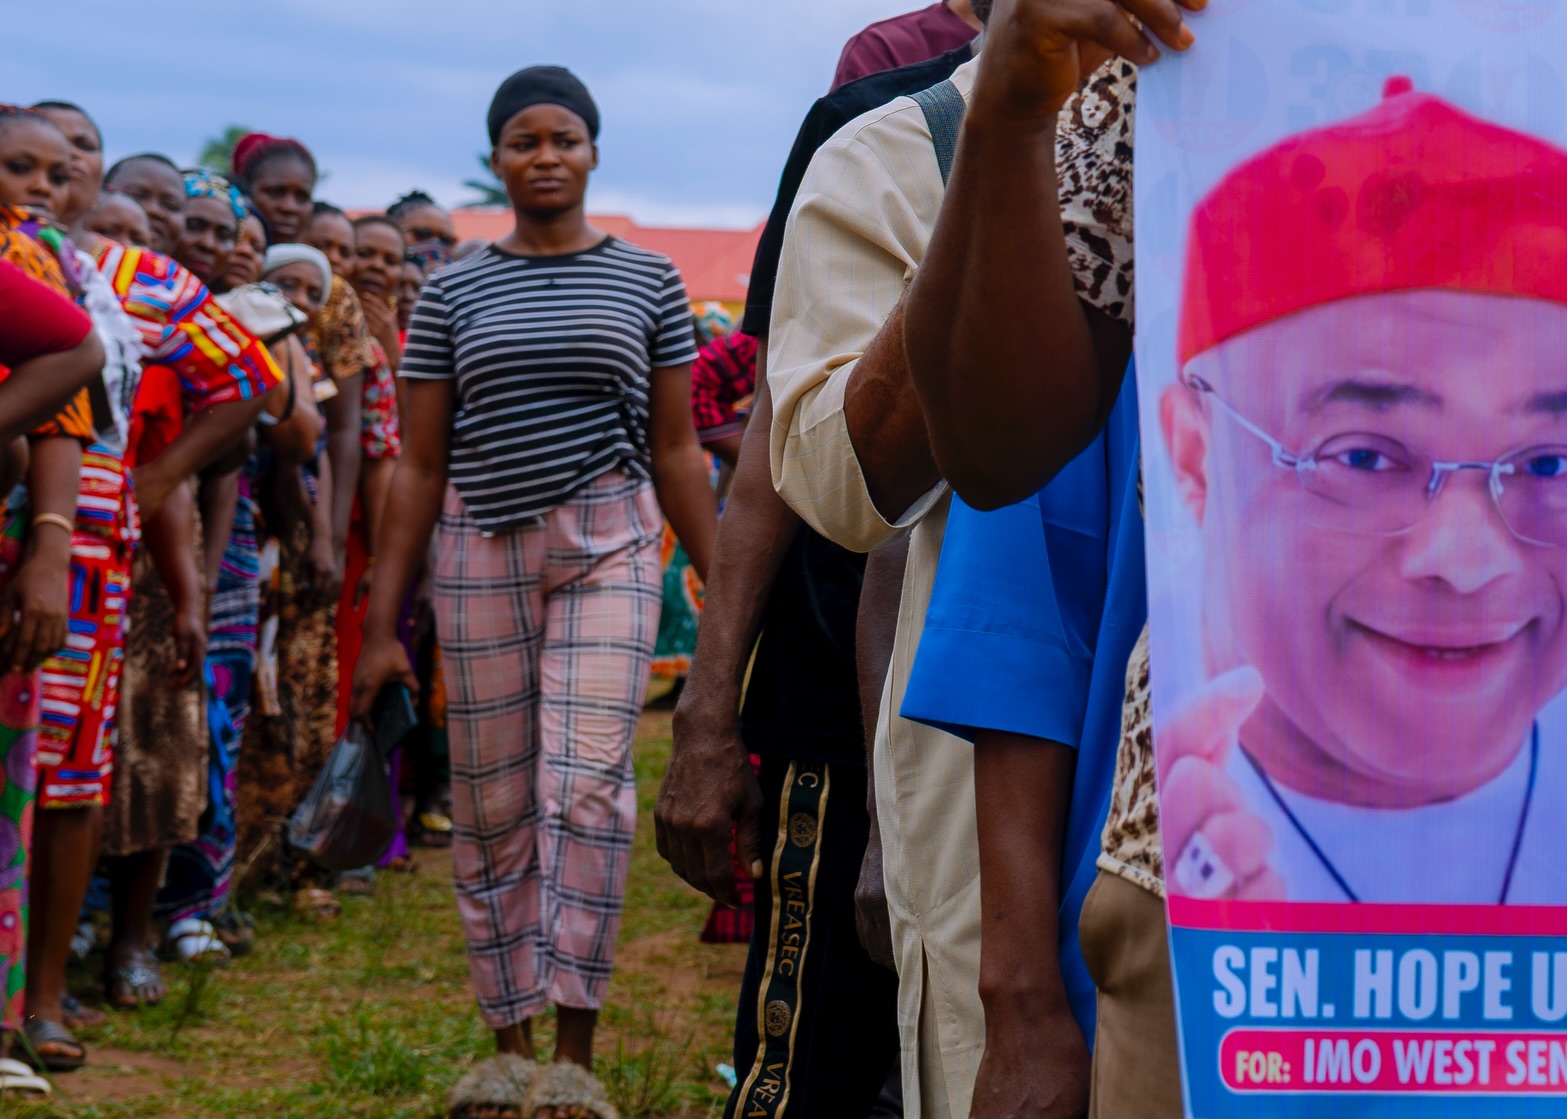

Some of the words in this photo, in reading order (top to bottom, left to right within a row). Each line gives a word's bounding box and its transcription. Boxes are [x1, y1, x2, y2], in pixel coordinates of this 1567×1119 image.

[778, 871, 805, 977] VREASEC
[1213, 945, 1334, 1018] SEN.
[1354, 949, 1512, 1020] HOPE
[1236, 1051, 1291, 1083] FOR:
[1303, 1039, 1381, 1084] IMO
[1393, 1039, 1496, 1085] WEST
